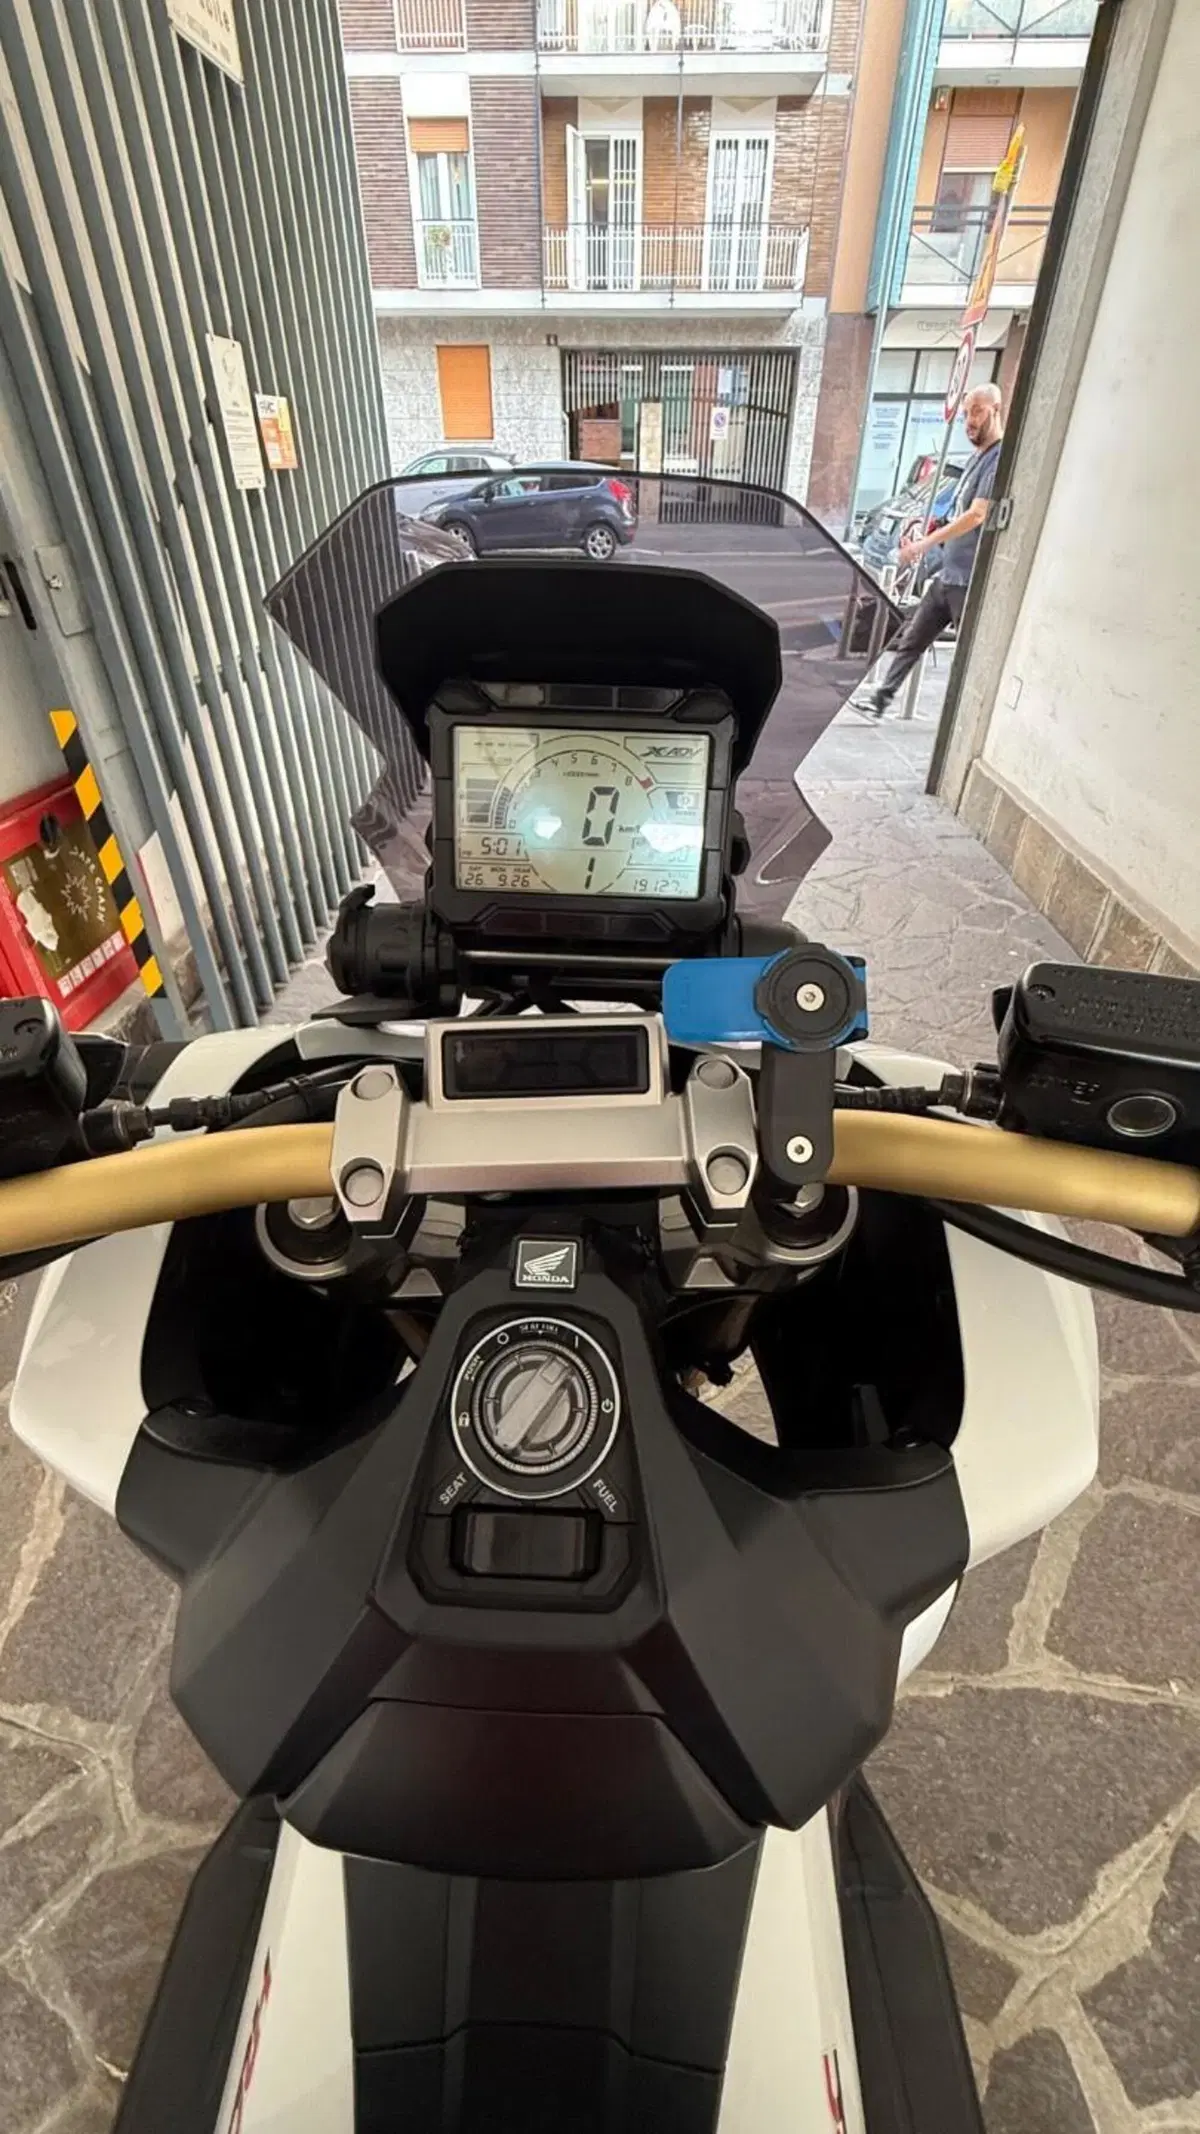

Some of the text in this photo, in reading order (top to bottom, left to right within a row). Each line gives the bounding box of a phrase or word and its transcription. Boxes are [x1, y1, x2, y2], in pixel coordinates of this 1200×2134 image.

[581, 786, 620, 847] 0
[481, 837, 522, 856] 5:01
[464, 873, 484, 886] 26
[584, 857, 596, 890] 1
[522, 1274, 570, 1284] HONDA
[439, 1471, 468, 1506] SEAT
[592, 1479, 619, 1513] FUEL
